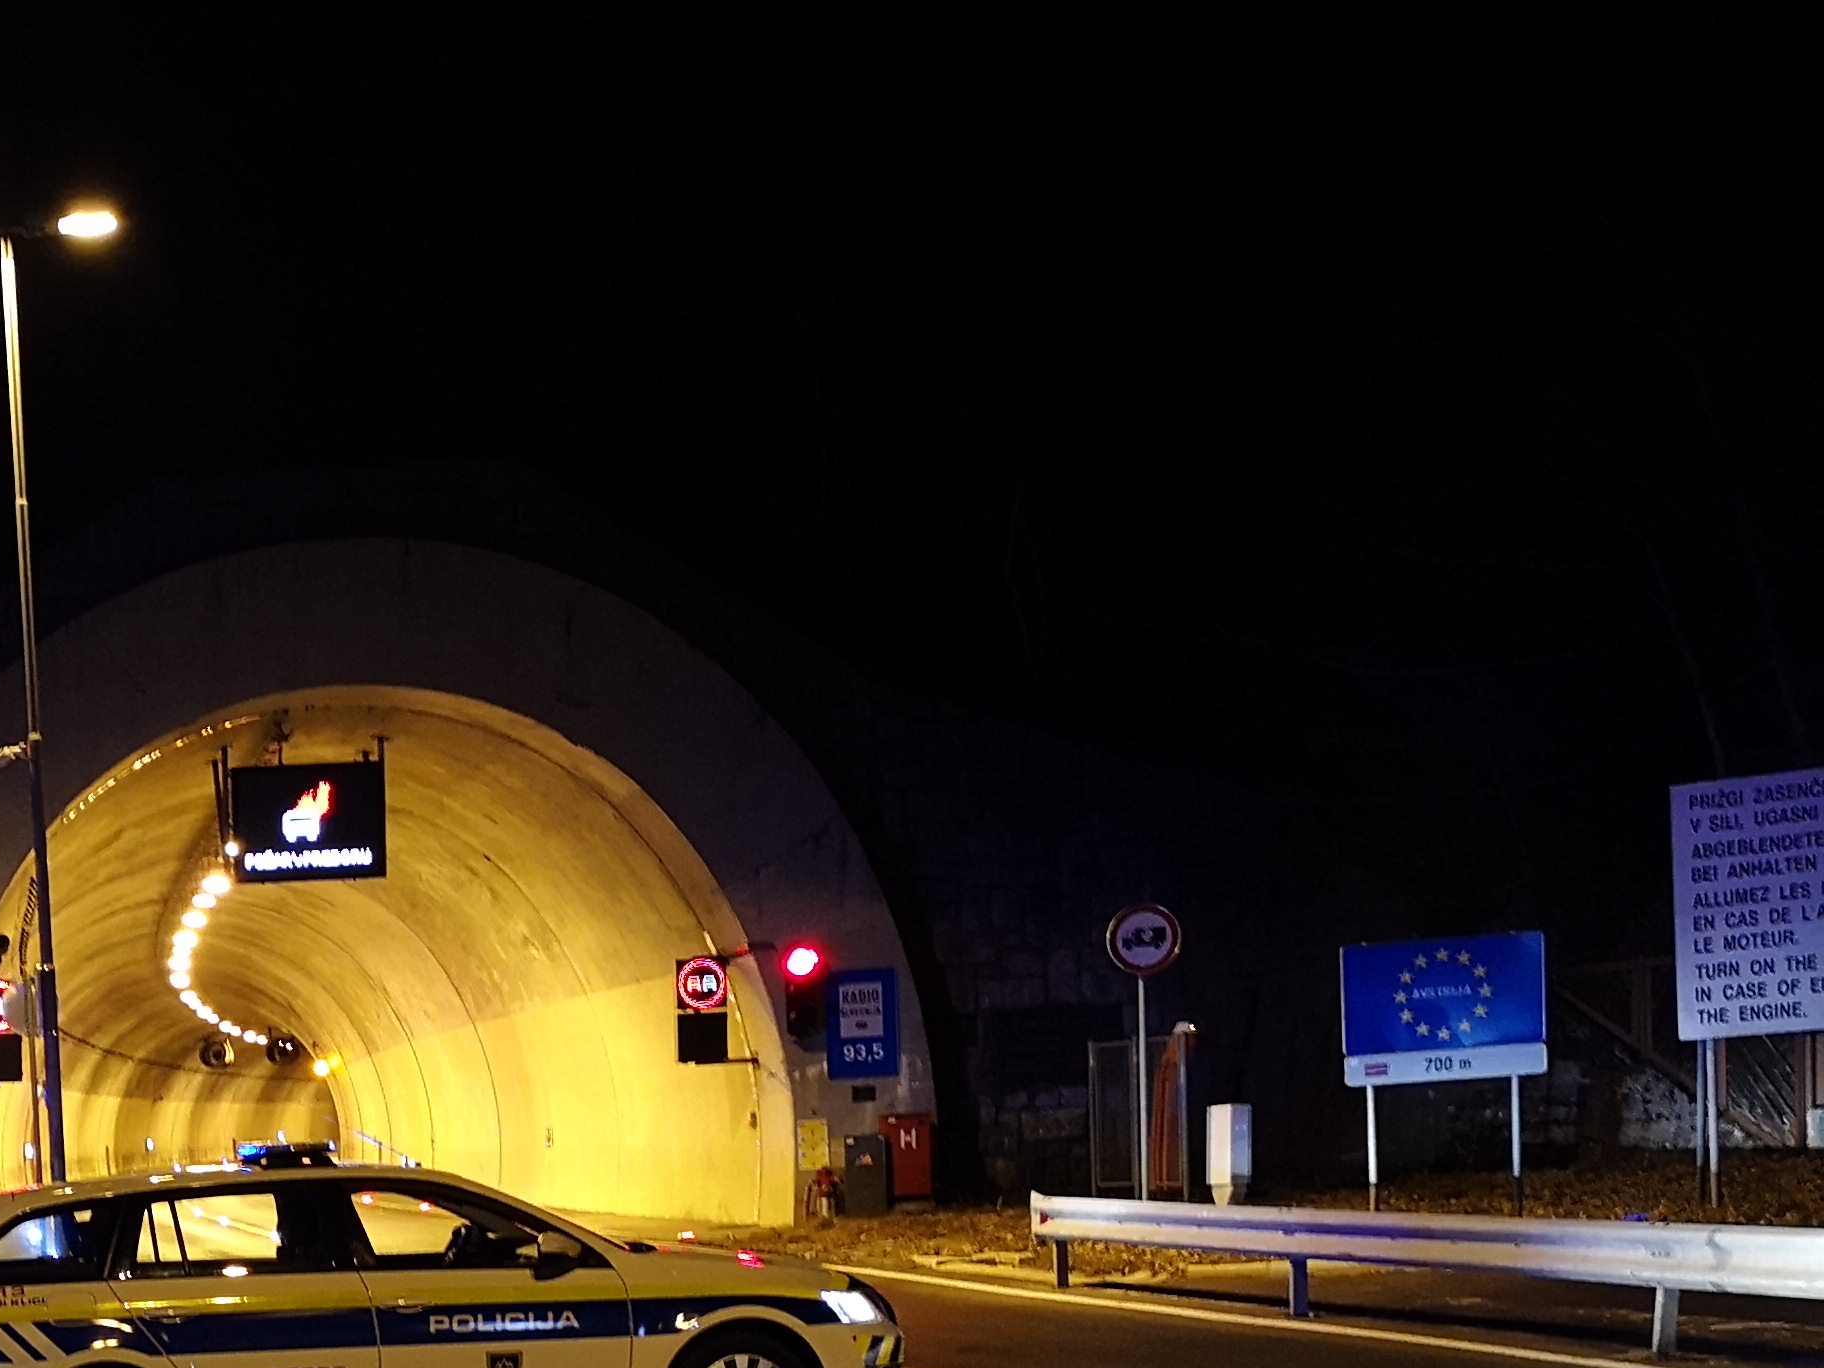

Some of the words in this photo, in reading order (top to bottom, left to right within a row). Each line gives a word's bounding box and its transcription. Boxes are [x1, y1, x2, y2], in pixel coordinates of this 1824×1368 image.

[1753, 777, 1824, 805] ZASENČ
[1690, 818, 1700, 834] V
[1754, 805, 1818, 827] UGASNI
[1691, 865, 1717, 884] BEI
[1727, 855, 1816, 879] ANHALTEN
[1693, 886, 1770, 910] ALLUMEZ
[1779, 881, 1811, 900] LES
[1693, 915, 1715, 932] EN
[1725, 909, 1759, 929] CAS
[1769, 907, 1792, 924] DE
[1694, 937, 1714, 954] LE
[1695, 960, 1740, 980] TURN
[1750, 958, 1776, 976] ON
[1786, 953, 1818, 972] THE
[841, 988, 880, 1005] RADIO
[1695, 986, 1712, 1003] IN
[1723, 981, 1768, 1001] CASE
[1777, 977, 1801, 996] OF
[1697, 1007, 1730, 1025] THE
[1739, 1001, 1808, 1022] ENGINE.
[843, 1042, 885, 1064] 93,5
[1425, 1056, 1452, 1073] 700
[1459, 1059, 1472, 1070] m
[900, 1127, 917, 1150] H
[429, 1310, 580, 1334] POLICIJA
